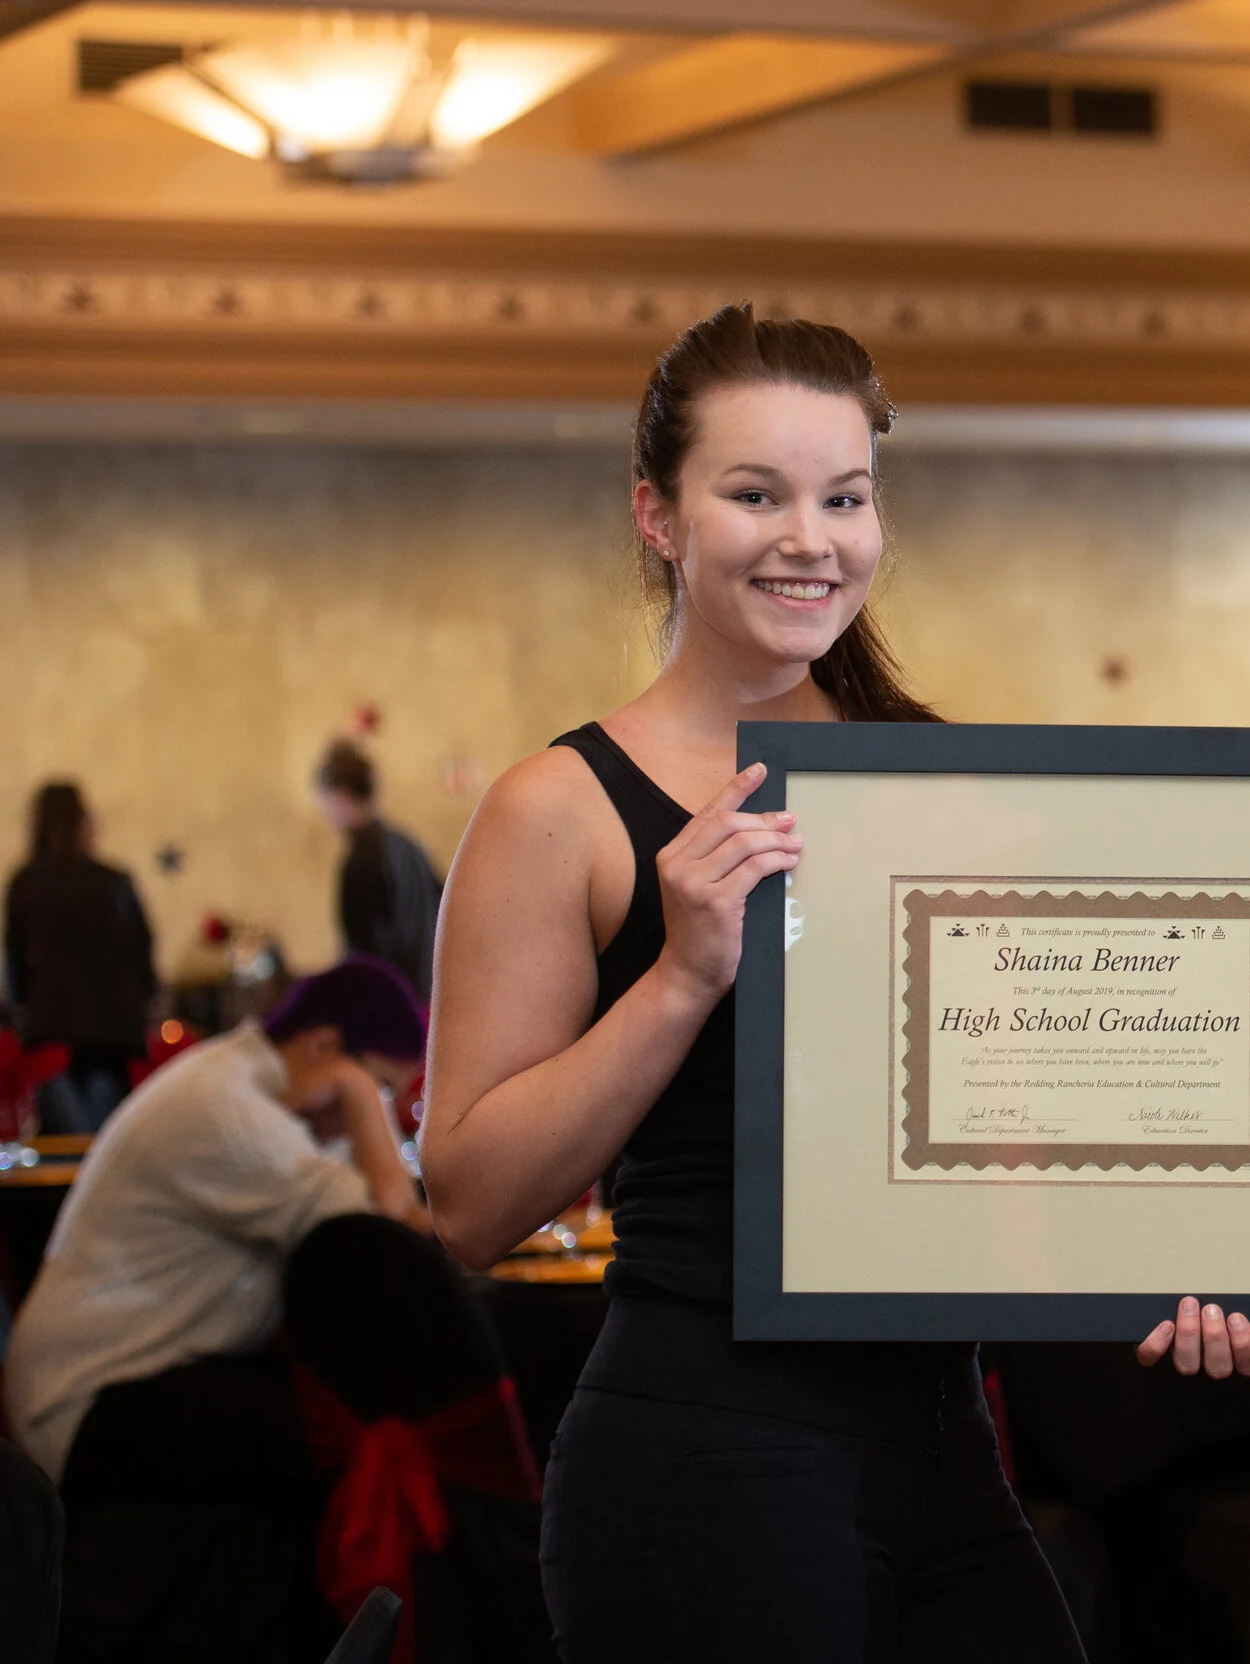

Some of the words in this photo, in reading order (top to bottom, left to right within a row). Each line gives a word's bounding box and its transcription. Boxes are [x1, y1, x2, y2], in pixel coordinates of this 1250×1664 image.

[1020, 927, 1037, 936] This
[1038, 927, 1073, 938] certificate
[1075, 927, 1081, 936] is
[1082, 927, 1111, 938] proudly
[1112, 927, 1146, 938] presented
[1148, 929, 1156, 937] to
[993, 946, 1083, 972] Shaina
[1090, 947, 1181, 972] Benner
[1012, 986, 1029, 995] This
[1030, 986, 1040, 995] 3rd
[1041, 986, 1056, 997] day
[1057, 986, 1067, 997] of
[1066, 986, 1093, 997] August
[1094, 986, 1114, 997] 2019,
[1116, 987, 1125, 996] in
[1126, 986, 1167, 997] recognition
[1167, 986, 1177, 997] of
[938, 1006, 1001, 1038] High
[1009, 1006, 1091, 1032] School
[1098, 1007, 1241, 1033] Graduation
[1008, 1047, 1032, 1056] journey
[1033, 1046, 1051, 1055] takes
[1051, 1048, 1064, 1056] you
[1091, 1046, 1104, 1055] and
[1104, 1046, 1130, 1056] upward
[1131, 1047, 1138, 1055] in
[1167, 1048, 1180, 1057] you
[1181, 1046, 1196, 1055] have
[1197, 1046, 1207, 1055] the
[961, 1057, 985, 1068] Eagle's
[1006, 1058, 1014, 1066] to
[1025, 1057, 1044, 1066] where
[1044, 1059, 1057, 1068] you
[1058, 1057, 1073, 1066] have
[1092, 1057, 1110, 1066] where
[1111, 1059, 1124, 1068] you
[1151, 1057, 1165, 1066] and
[1166, 1057, 1184, 1067] where
[1184, 1059, 1197, 1068] you
[1198, 1057, 1211, 1067] will
[963, 1079, 998, 1088] Presented
[999, 1079, 1009, 1090] by
[1010, 1079, 1022, 1088] the
[1023, 1079, 1055, 1090] Redding
[1056, 1079, 1095, 1089] Rancheria
[1096, 1079, 1134, 1089] Education
[1135, 1080, 1143, 1089] &
[1144, 1079, 1176, 1089] Cultural
[1177, 1080, 1221, 1091] Department
[959, 1124, 988, 1135] Cultural
[989, 1124, 1029, 1136] Department
[1031, 1124, 1067, 1137] Manager
[1142, 1124, 1177, 1135] Education
[1179, 1124, 1209, 1135] Director
